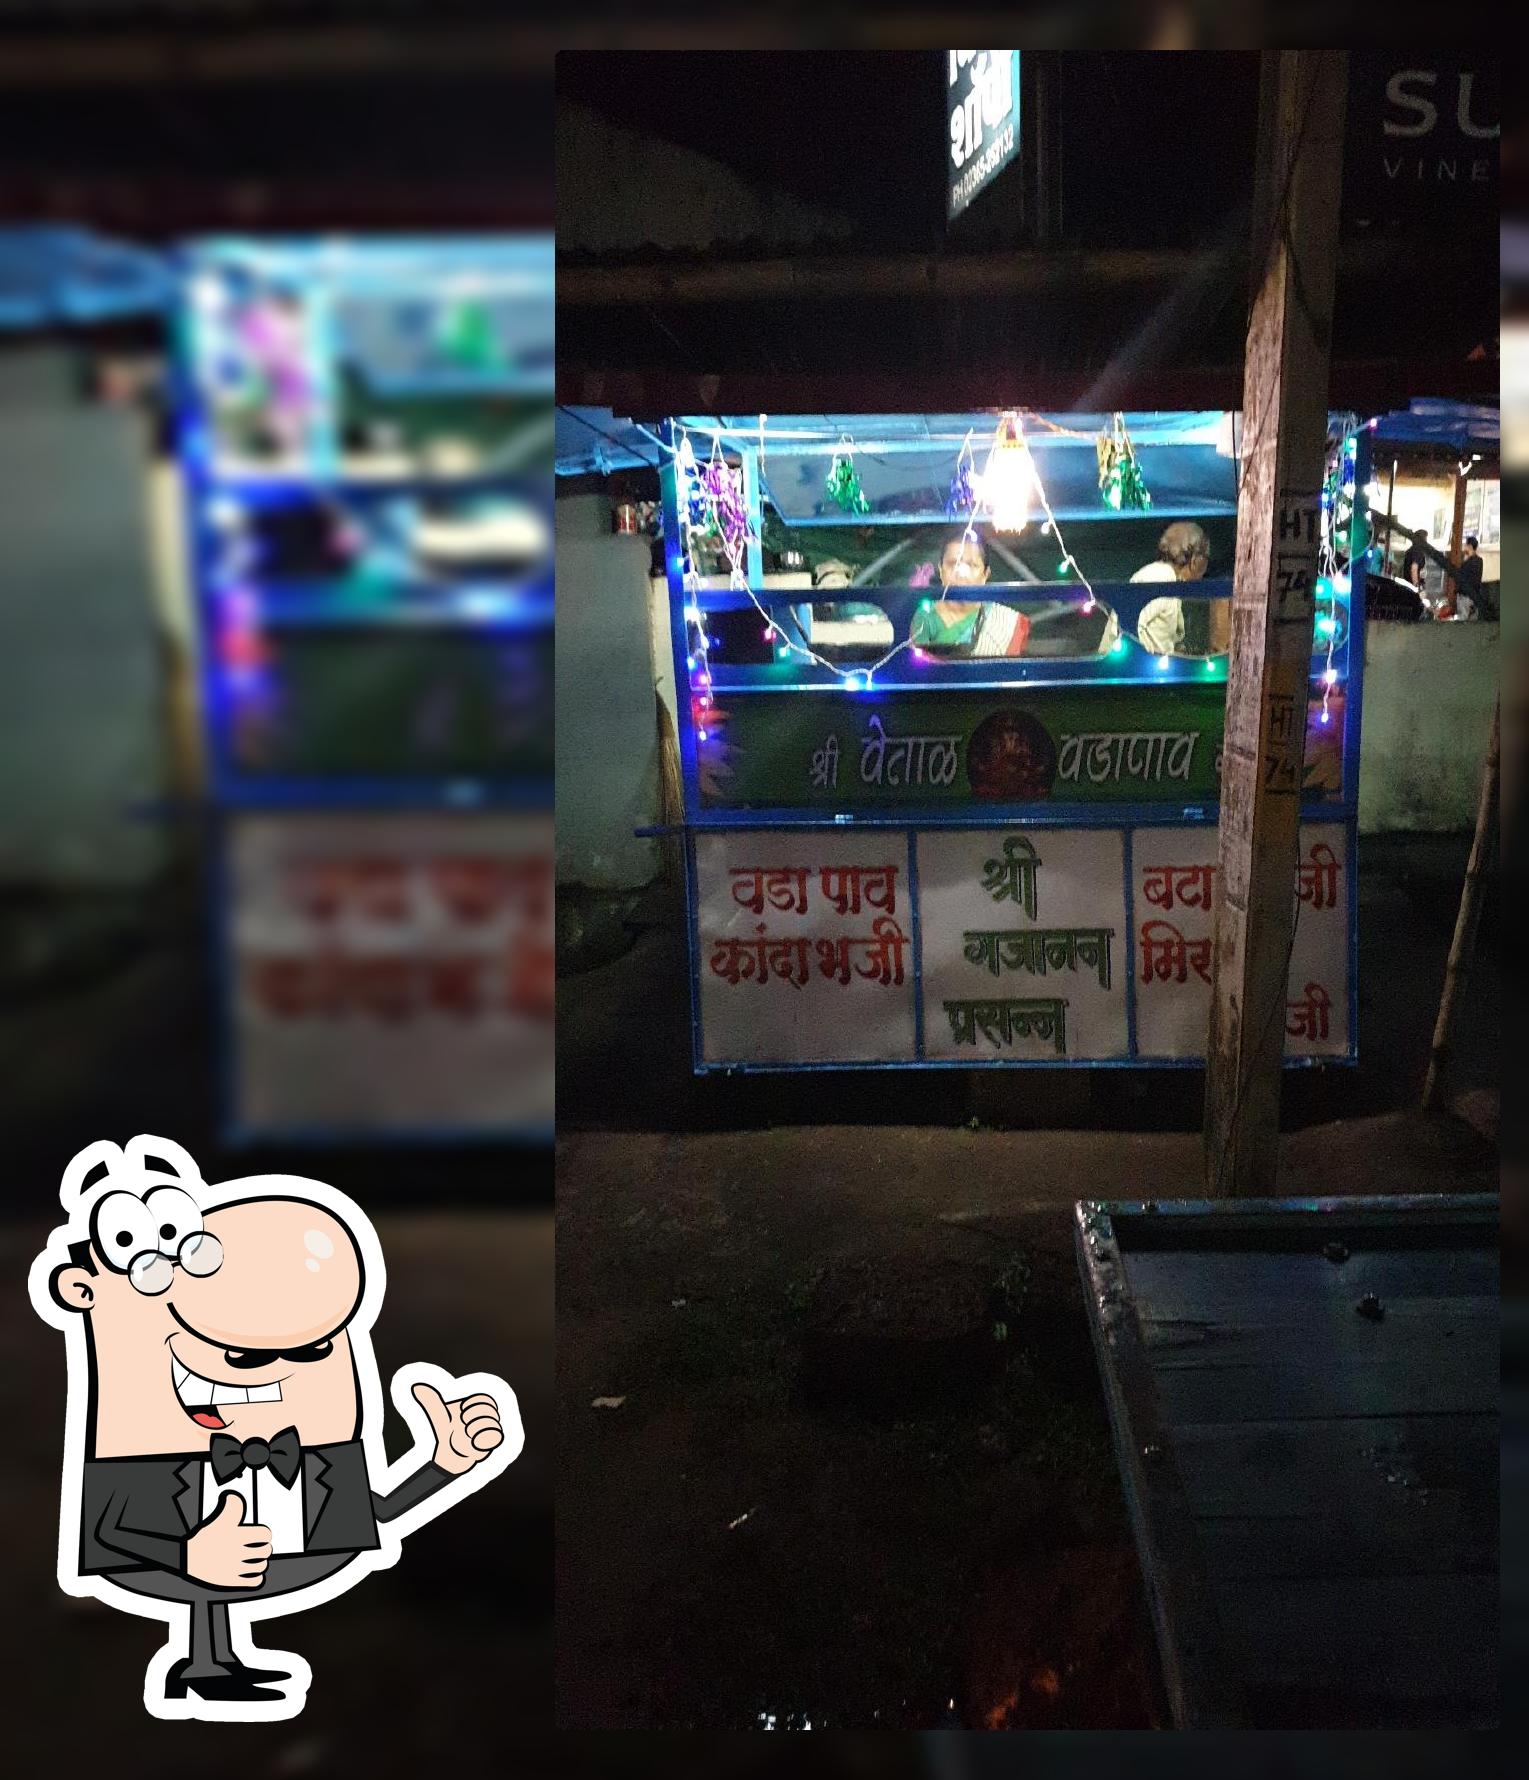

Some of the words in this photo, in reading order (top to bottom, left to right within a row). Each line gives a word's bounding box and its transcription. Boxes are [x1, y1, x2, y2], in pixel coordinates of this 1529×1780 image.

[1384, 158, 1490, 182] VINE
[810, 733, 840, 788] श्री
[860, 713, 963, 786] वेताळ
[1057, 731, 1200, 783] वडापाव
[729, 867, 811, 915] वडा
[819, 865, 899, 915] पाव
[981, 835, 1042, 921] श्री
[1143, 864, 1217, 911] बटा
[710, 921, 811, 991] कांदा
[816, 917, 910, 986] भजी
[963, 928, 1115, 991] गजानन
[1140, 919, 1214, 985] मिर
[943, 998, 1070, 1055] प्रसन्न
